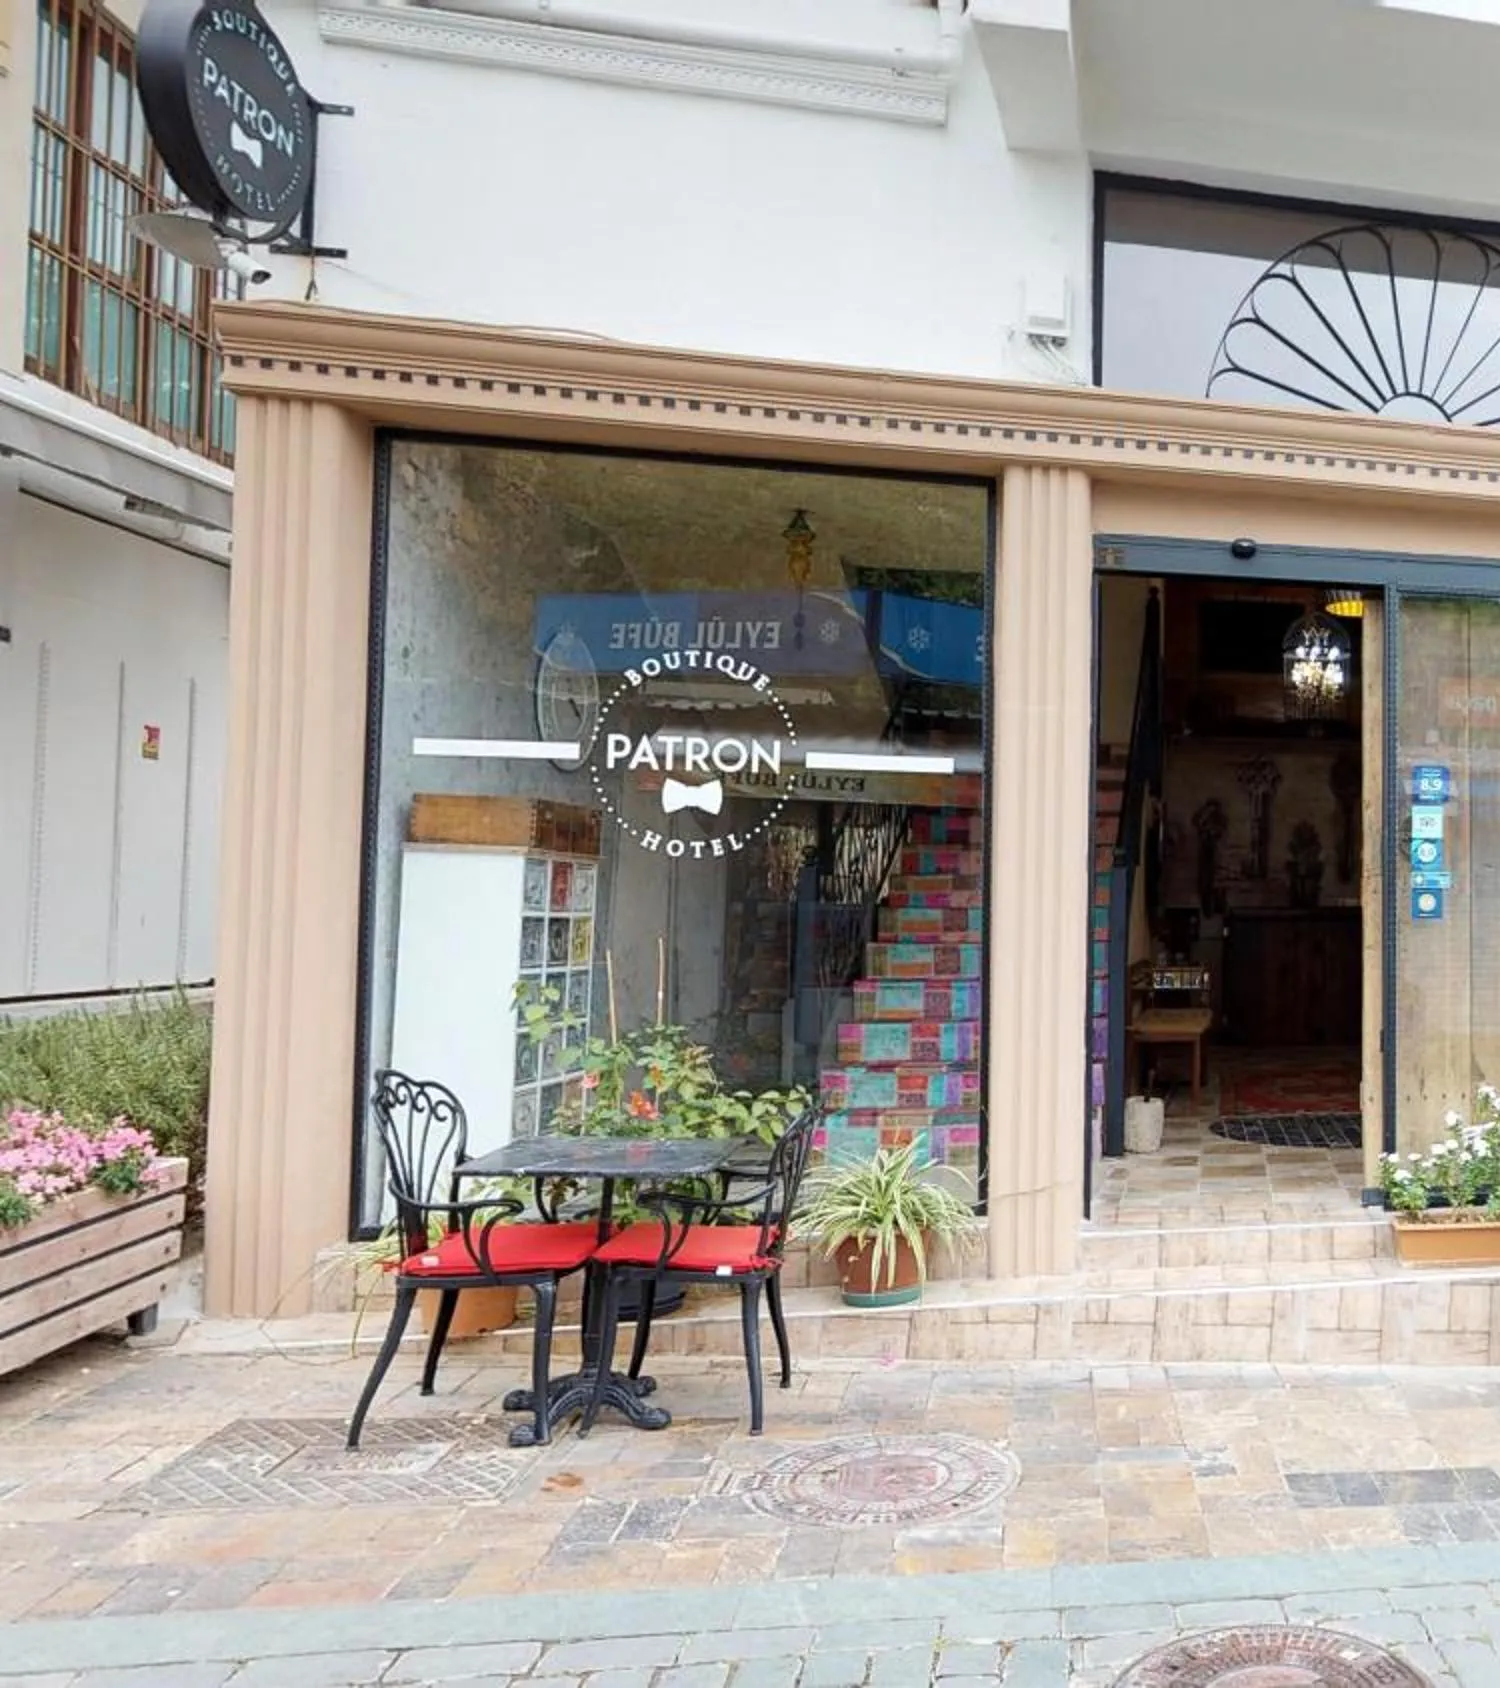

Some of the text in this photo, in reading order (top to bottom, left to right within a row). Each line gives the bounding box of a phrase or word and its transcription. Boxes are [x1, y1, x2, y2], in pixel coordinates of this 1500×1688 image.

[211, 9, 296, 96] BOUTIQUE
[202, 57, 294, 158] PATRON
[216, 154, 275, 211] HOTEL
[624, 650, 771, 691] BOUTIQUE
[606, 733, 781, 774] PATRON
[640, 829, 743, 859] HOTEL
